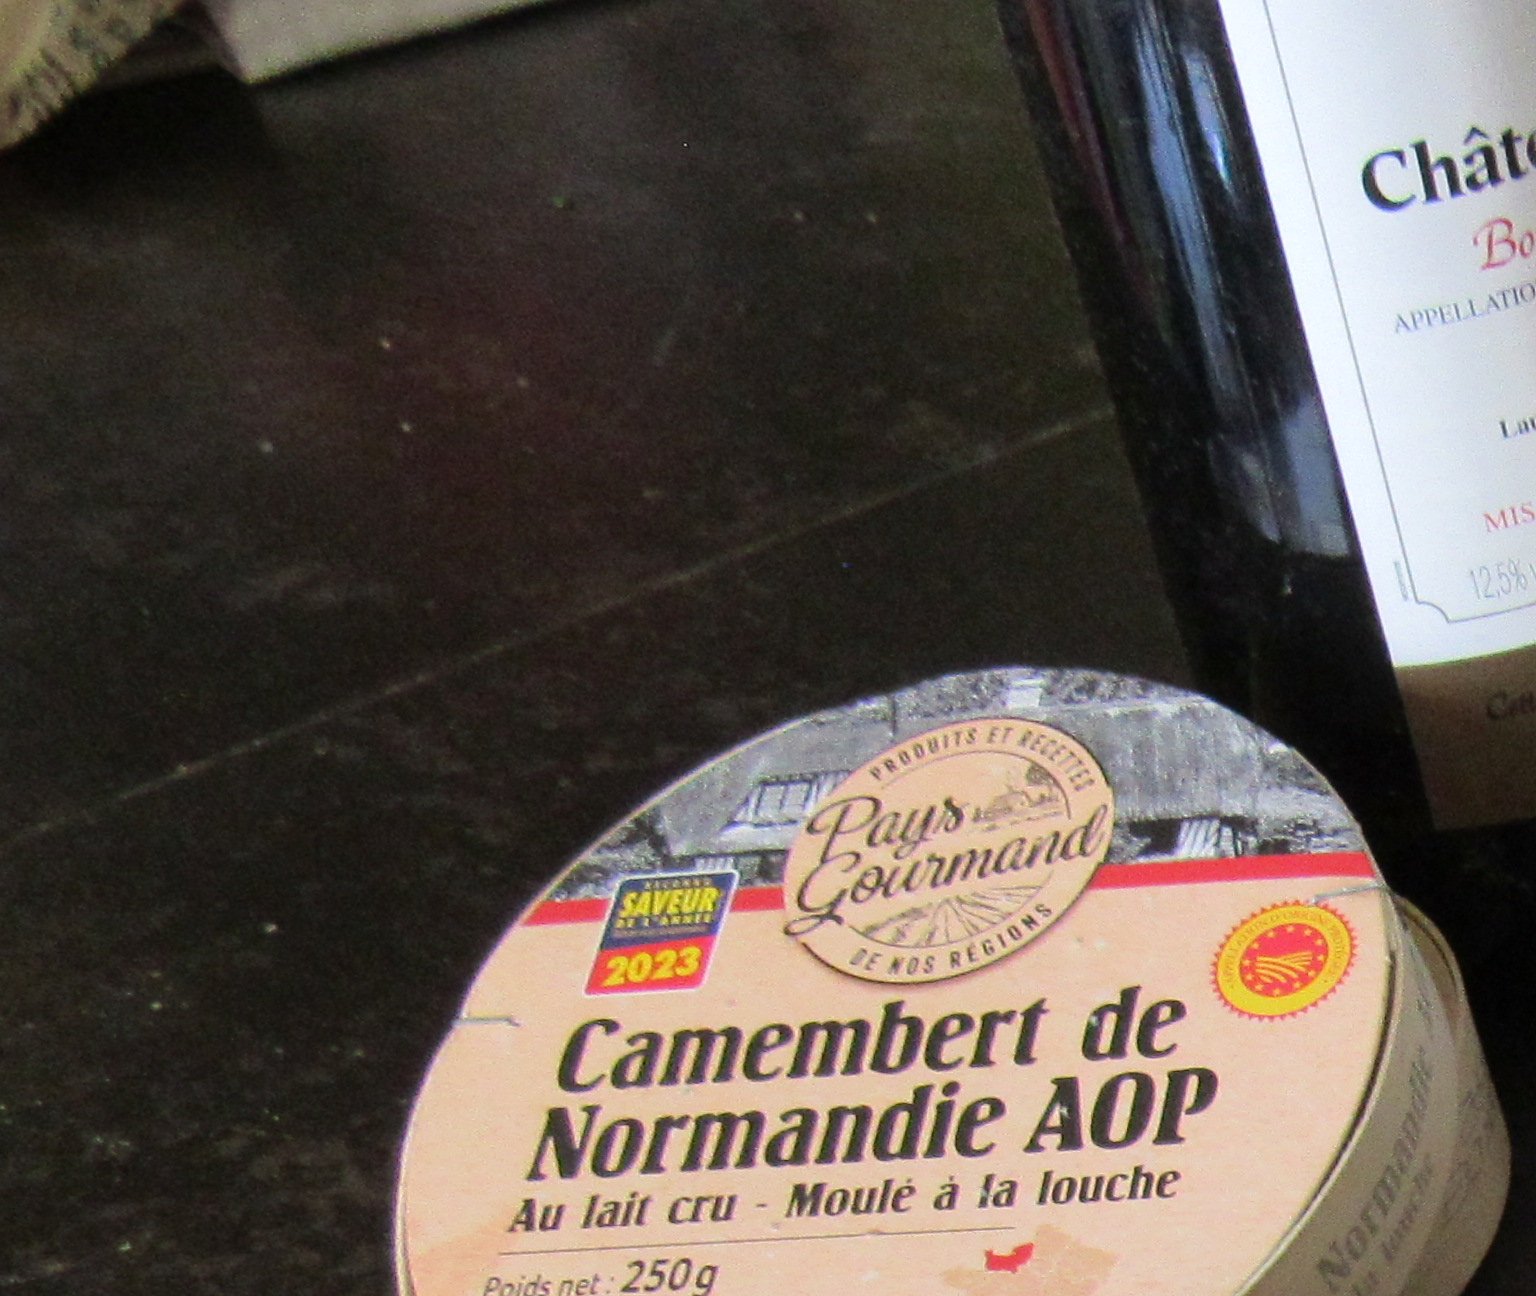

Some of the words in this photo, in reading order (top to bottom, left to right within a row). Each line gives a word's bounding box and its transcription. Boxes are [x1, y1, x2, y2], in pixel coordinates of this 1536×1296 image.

[1483, 504, 1536, 533] MIS
[870, 727, 978, 781] PRODUITS
[986, 726, 1010, 745] ET
[1017, 729, 1095, 793] RECETTES
[806, 796, 967, 866] Pays
[619, 887, 722, 918] SAVEUR
[783, 803, 1108, 936] Gourmand
[602, 945, 702, 988] 2023
[849, 947, 882, 972] DE
[888, 956, 936, 976] NOS
[556, 997, 1053, 1093] Camembert
[1080, 987, 1189, 1060] de
[525, 1080, 1006, 1182] Normandie
[1022, 1066, 1221, 1153] AOP
[505, 1196, 564, 1233] Au
[580, 1190, 648, 1229] lait
[666, 1192, 738, 1226] cru
[785, 1176, 916, 1220] Moulé
[932, 1174, 957, 1212] à
[977, 1174, 1020, 1210] la
[1036, 1167, 1183, 1207] louche
